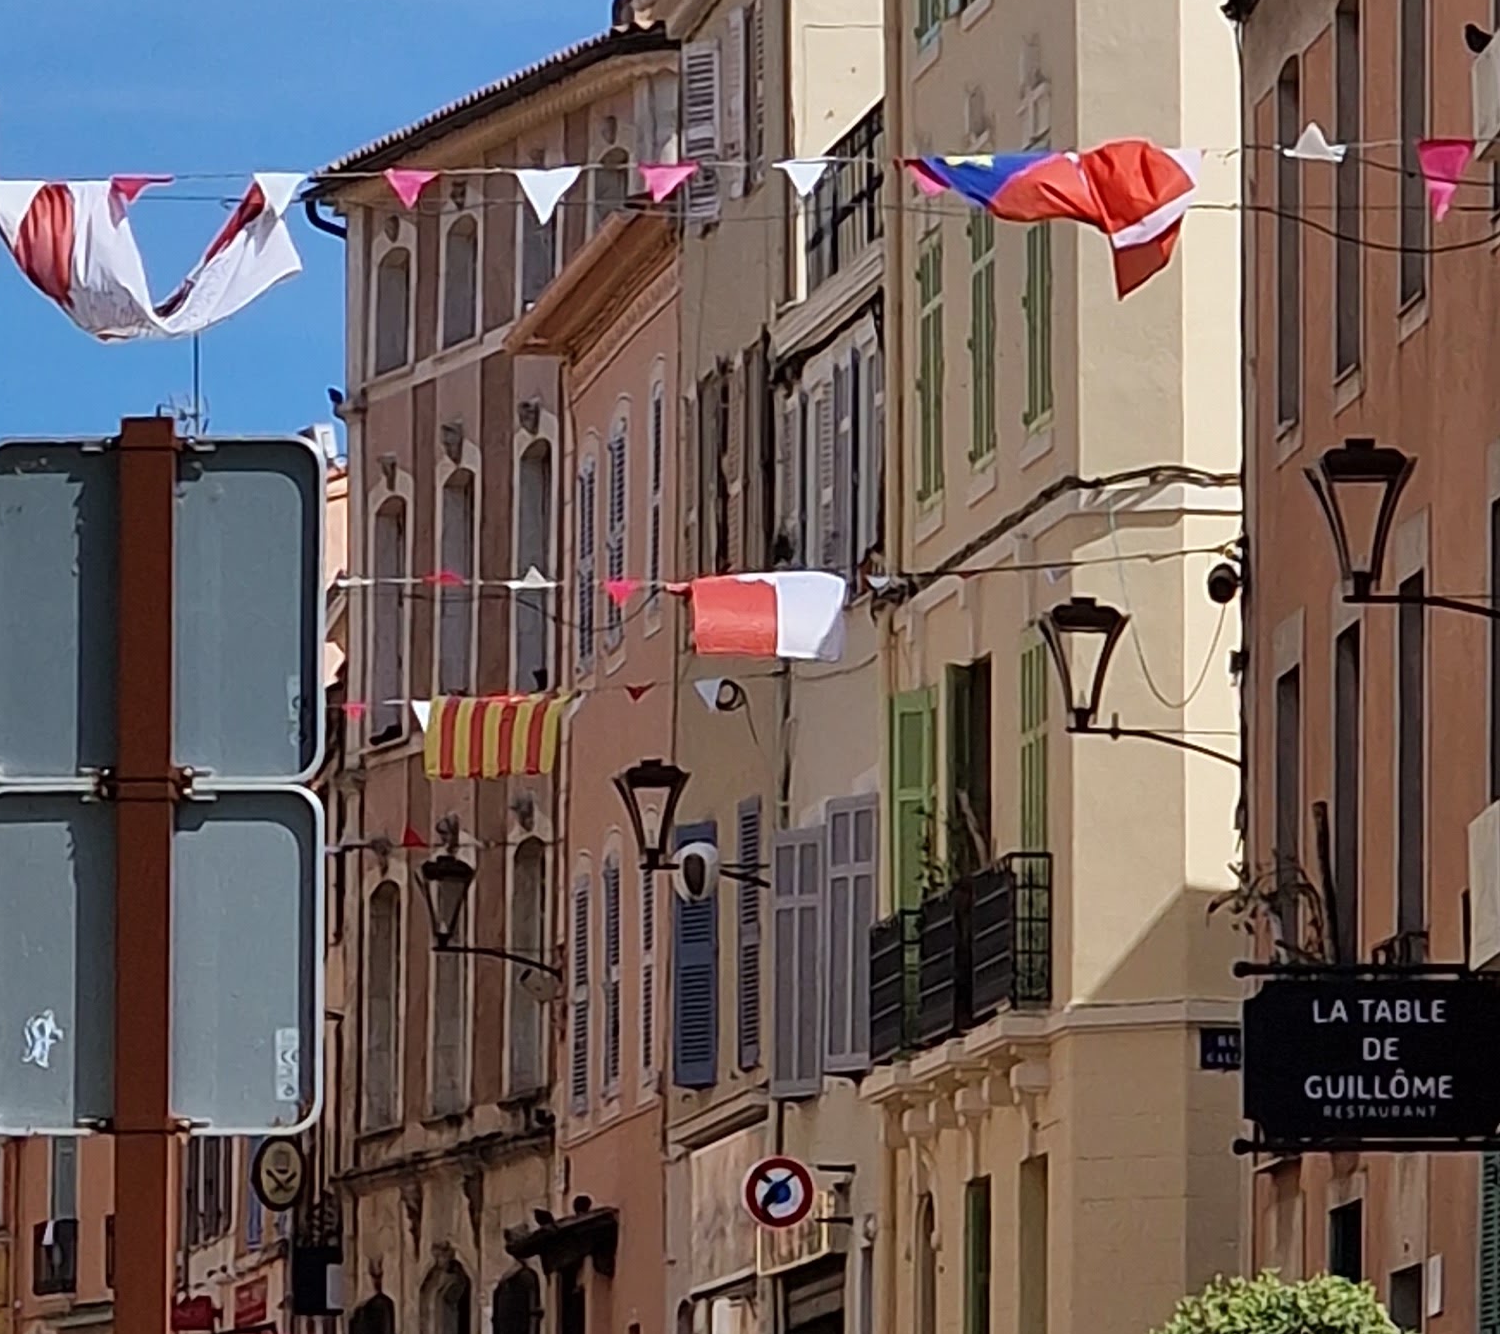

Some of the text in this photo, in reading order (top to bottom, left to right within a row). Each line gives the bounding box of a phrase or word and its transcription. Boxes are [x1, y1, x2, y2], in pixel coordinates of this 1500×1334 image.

[1312, 998, 1447, 1023] LA TABLE
[1362, 1037, 1400, 1061] DE
[1304, 1068, 1454, 1100] GUILLÔME
[1322, 1105, 1437, 1118] RESTAURANT
